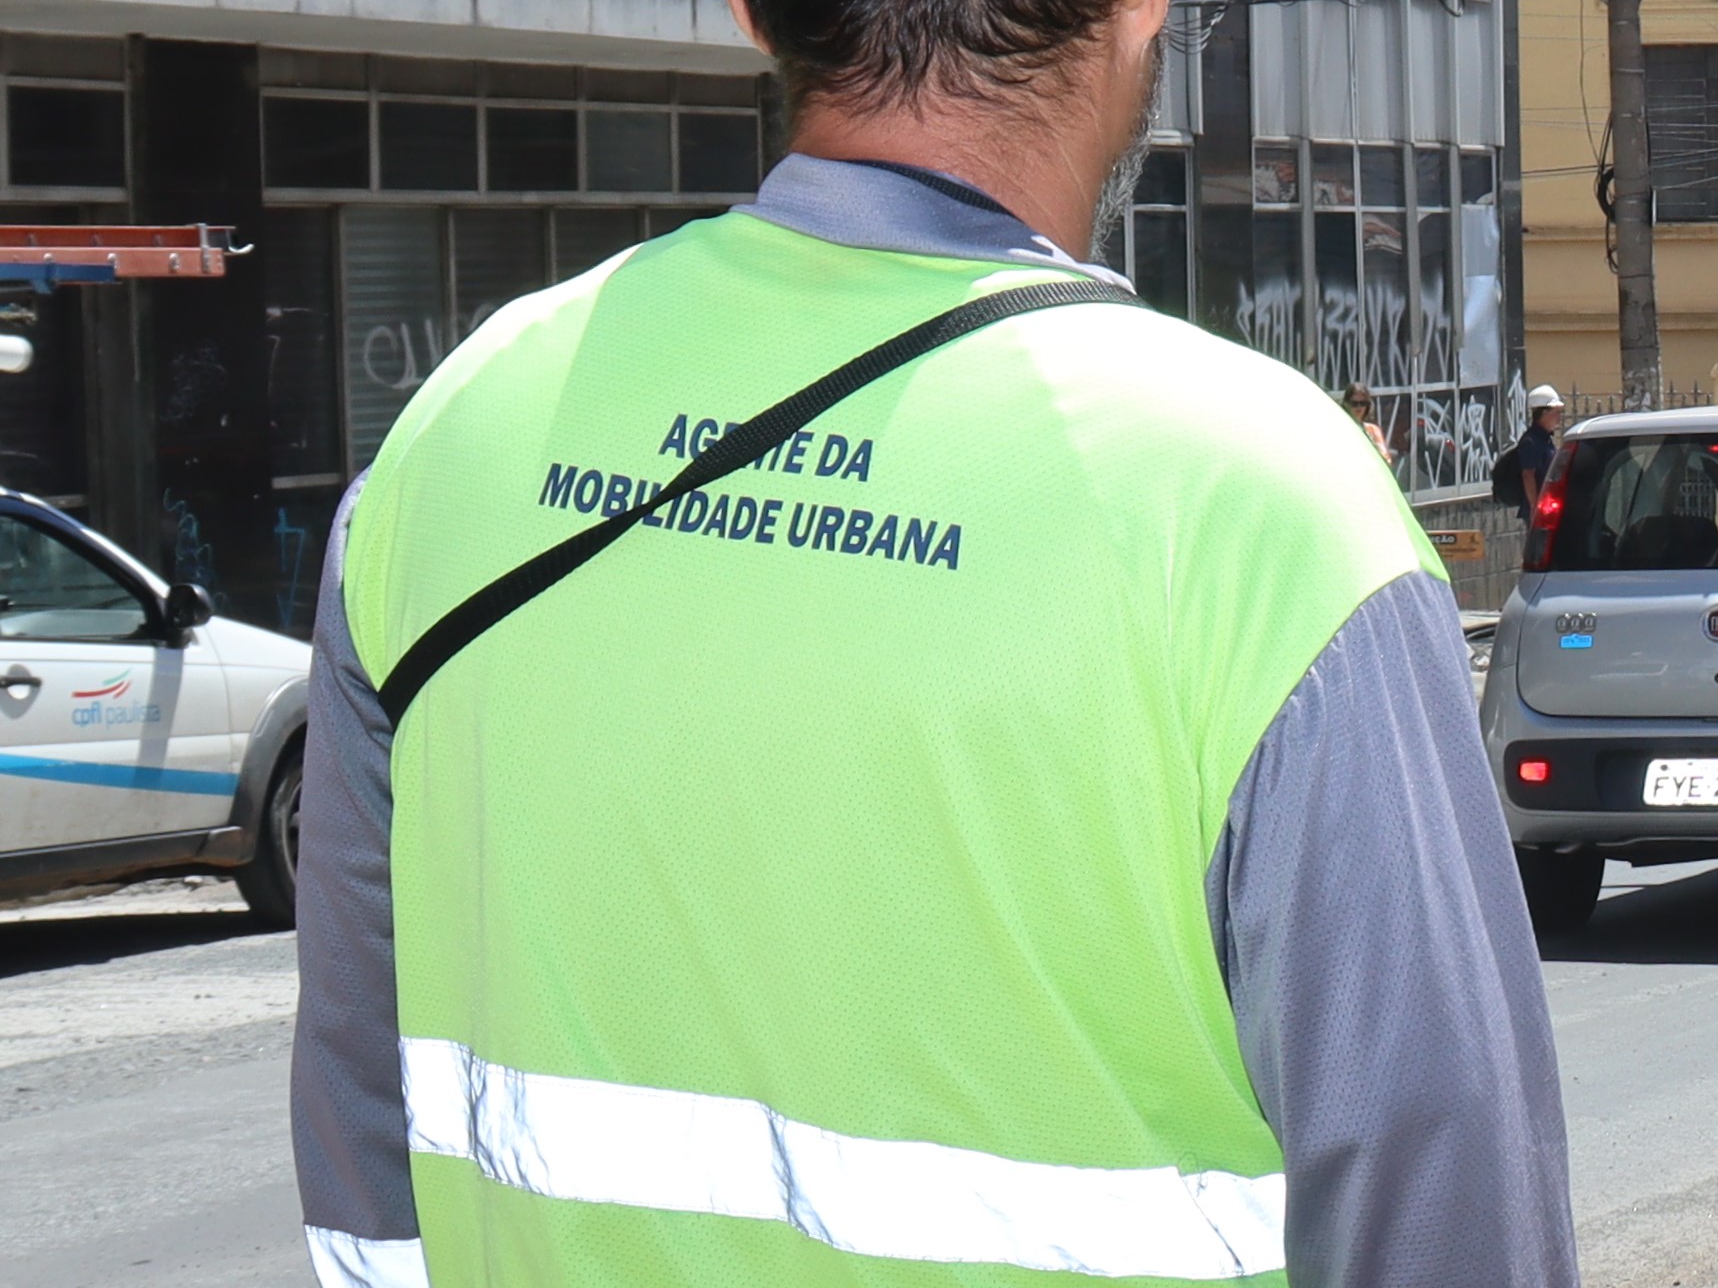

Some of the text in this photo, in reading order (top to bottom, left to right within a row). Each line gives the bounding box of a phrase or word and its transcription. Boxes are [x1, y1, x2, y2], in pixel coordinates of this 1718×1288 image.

[814, 433, 874, 482] DA
[786, 500, 963, 571] URBANA
[72, 699, 161, 730] cpfl paulista
